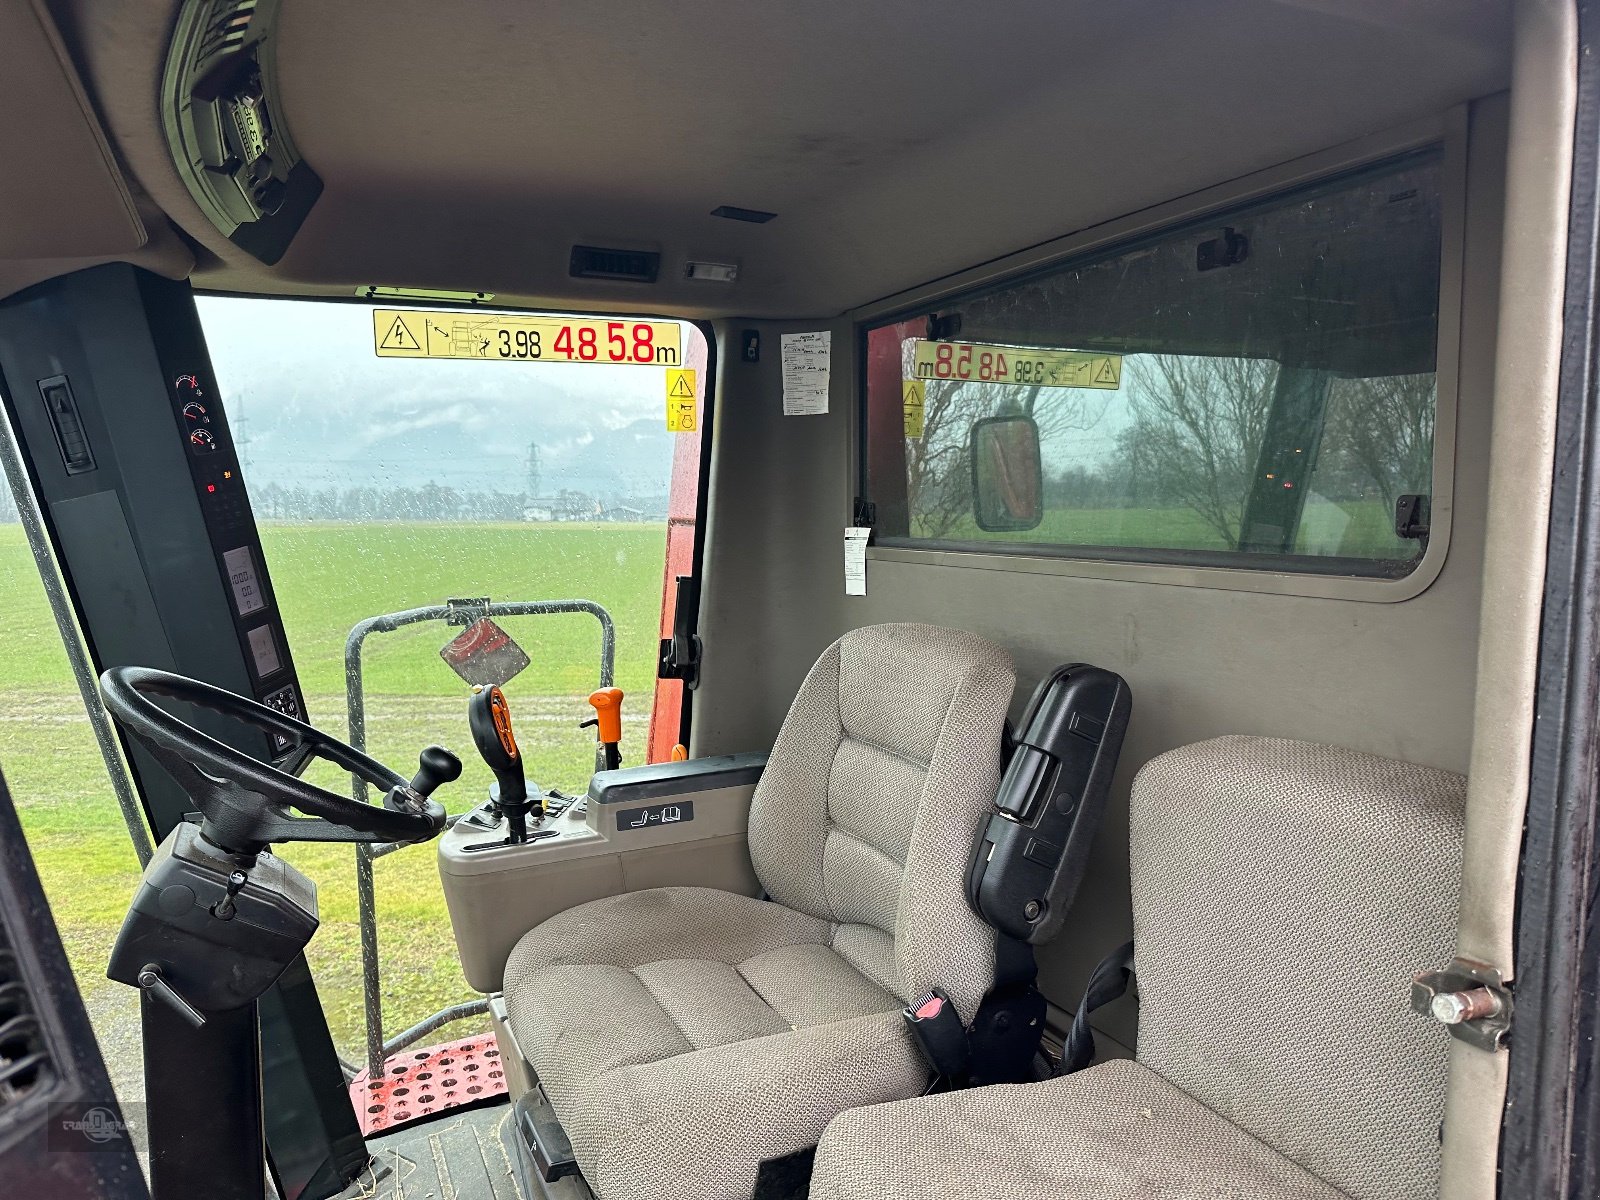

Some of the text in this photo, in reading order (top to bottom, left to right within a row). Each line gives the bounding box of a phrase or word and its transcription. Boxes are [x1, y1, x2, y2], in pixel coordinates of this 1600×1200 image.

[498, 322, 677, 364] 3.98 4.8 5.8 m
